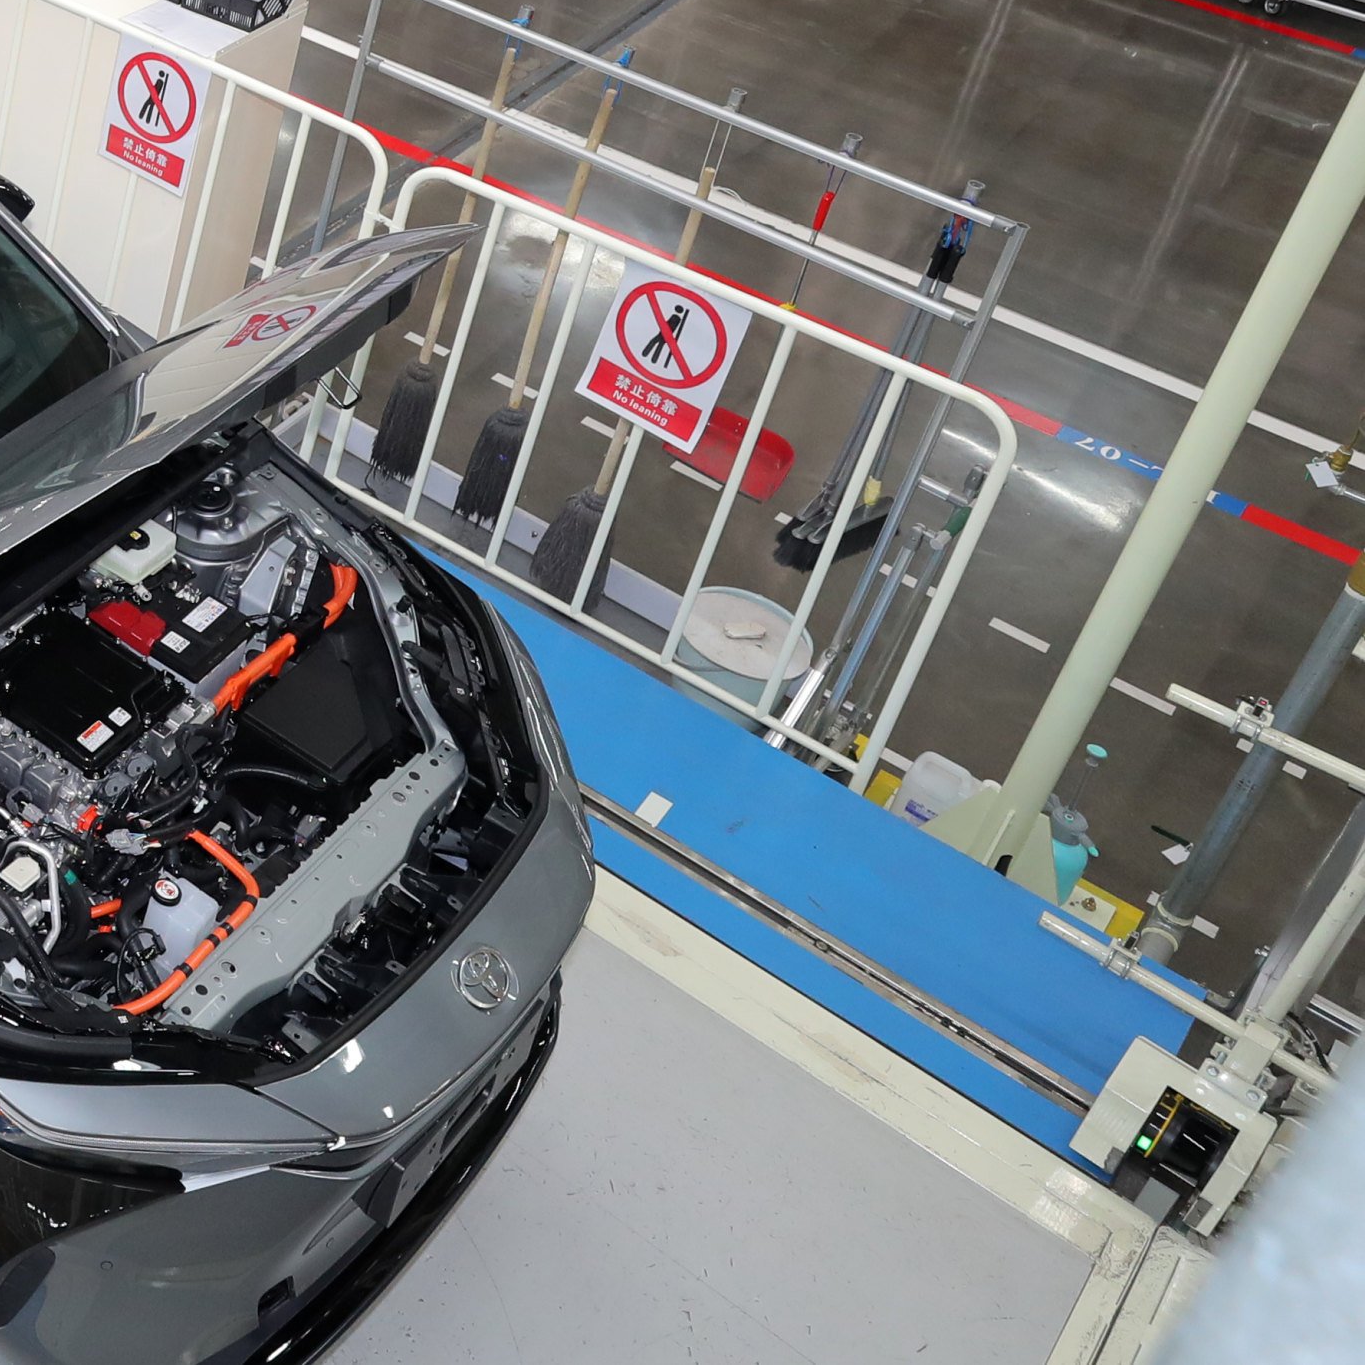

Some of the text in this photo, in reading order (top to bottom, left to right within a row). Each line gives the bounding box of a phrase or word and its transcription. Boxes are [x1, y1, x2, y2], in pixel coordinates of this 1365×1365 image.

[123, 137, 168, 168] 禁止倚靠
[123, 150, 164, 177] No leaning
[612, 390, 669, 427] No leaning
[615, 374, 678, 417] 禁止倚靠
